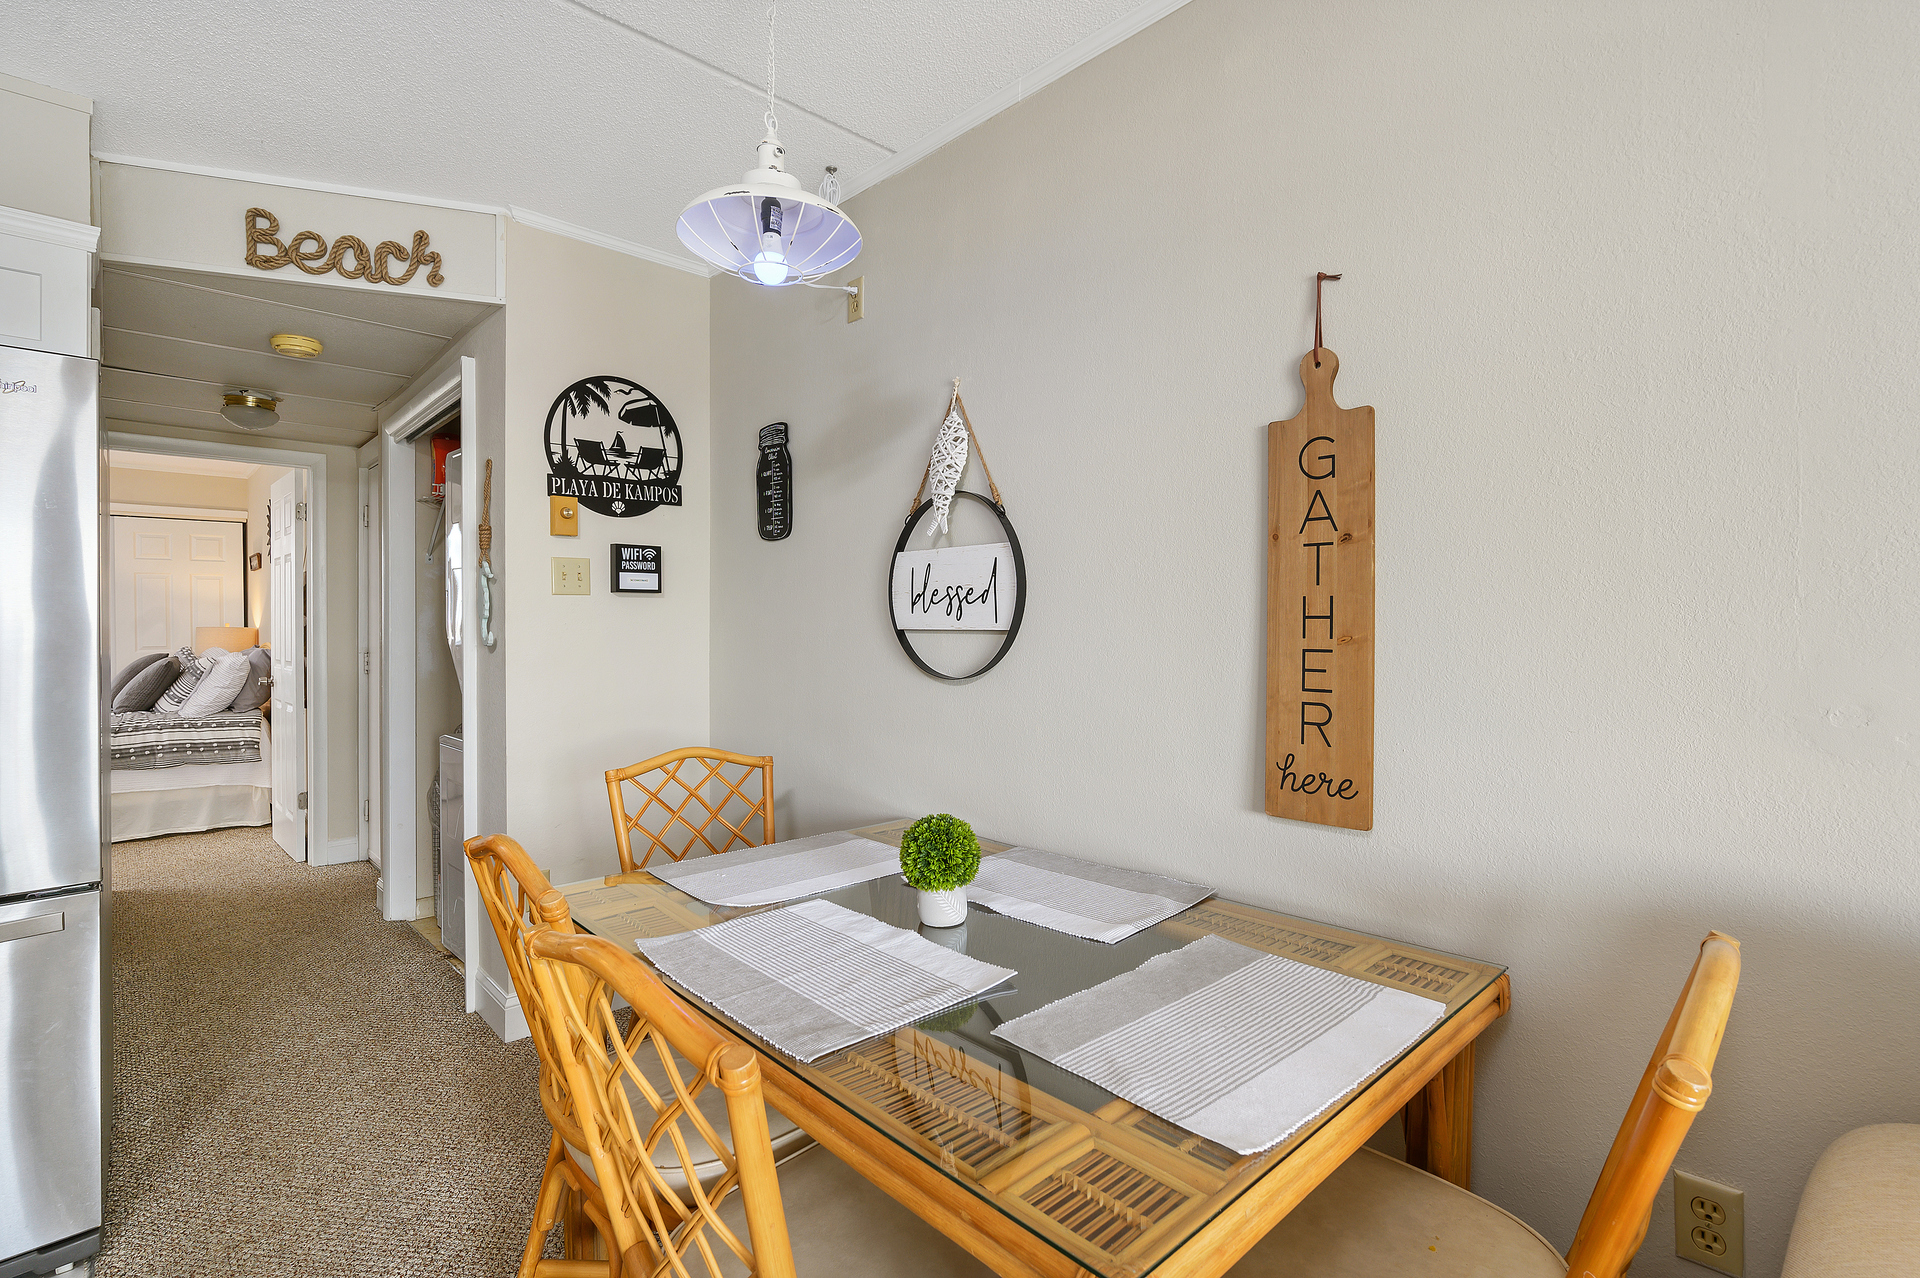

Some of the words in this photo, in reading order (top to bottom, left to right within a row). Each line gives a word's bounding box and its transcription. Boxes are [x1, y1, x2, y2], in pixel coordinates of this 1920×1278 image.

[244, 207, 445, 287] Beach
[0, 378, 38, 395] hirlpool
[552, 477, 599, 497] PLAYA
[602, 481, 621, 499] DE
[624, 484, 679, 503] KAMPOS
[621, 547, 642, 560] WIFI
[621, 560, 656, 570] PASSWORD
[910, 556, 998, 624] blessed
[1298, 436, 1339, 748] GATHER
[1276, 753, 1359, 800] here
